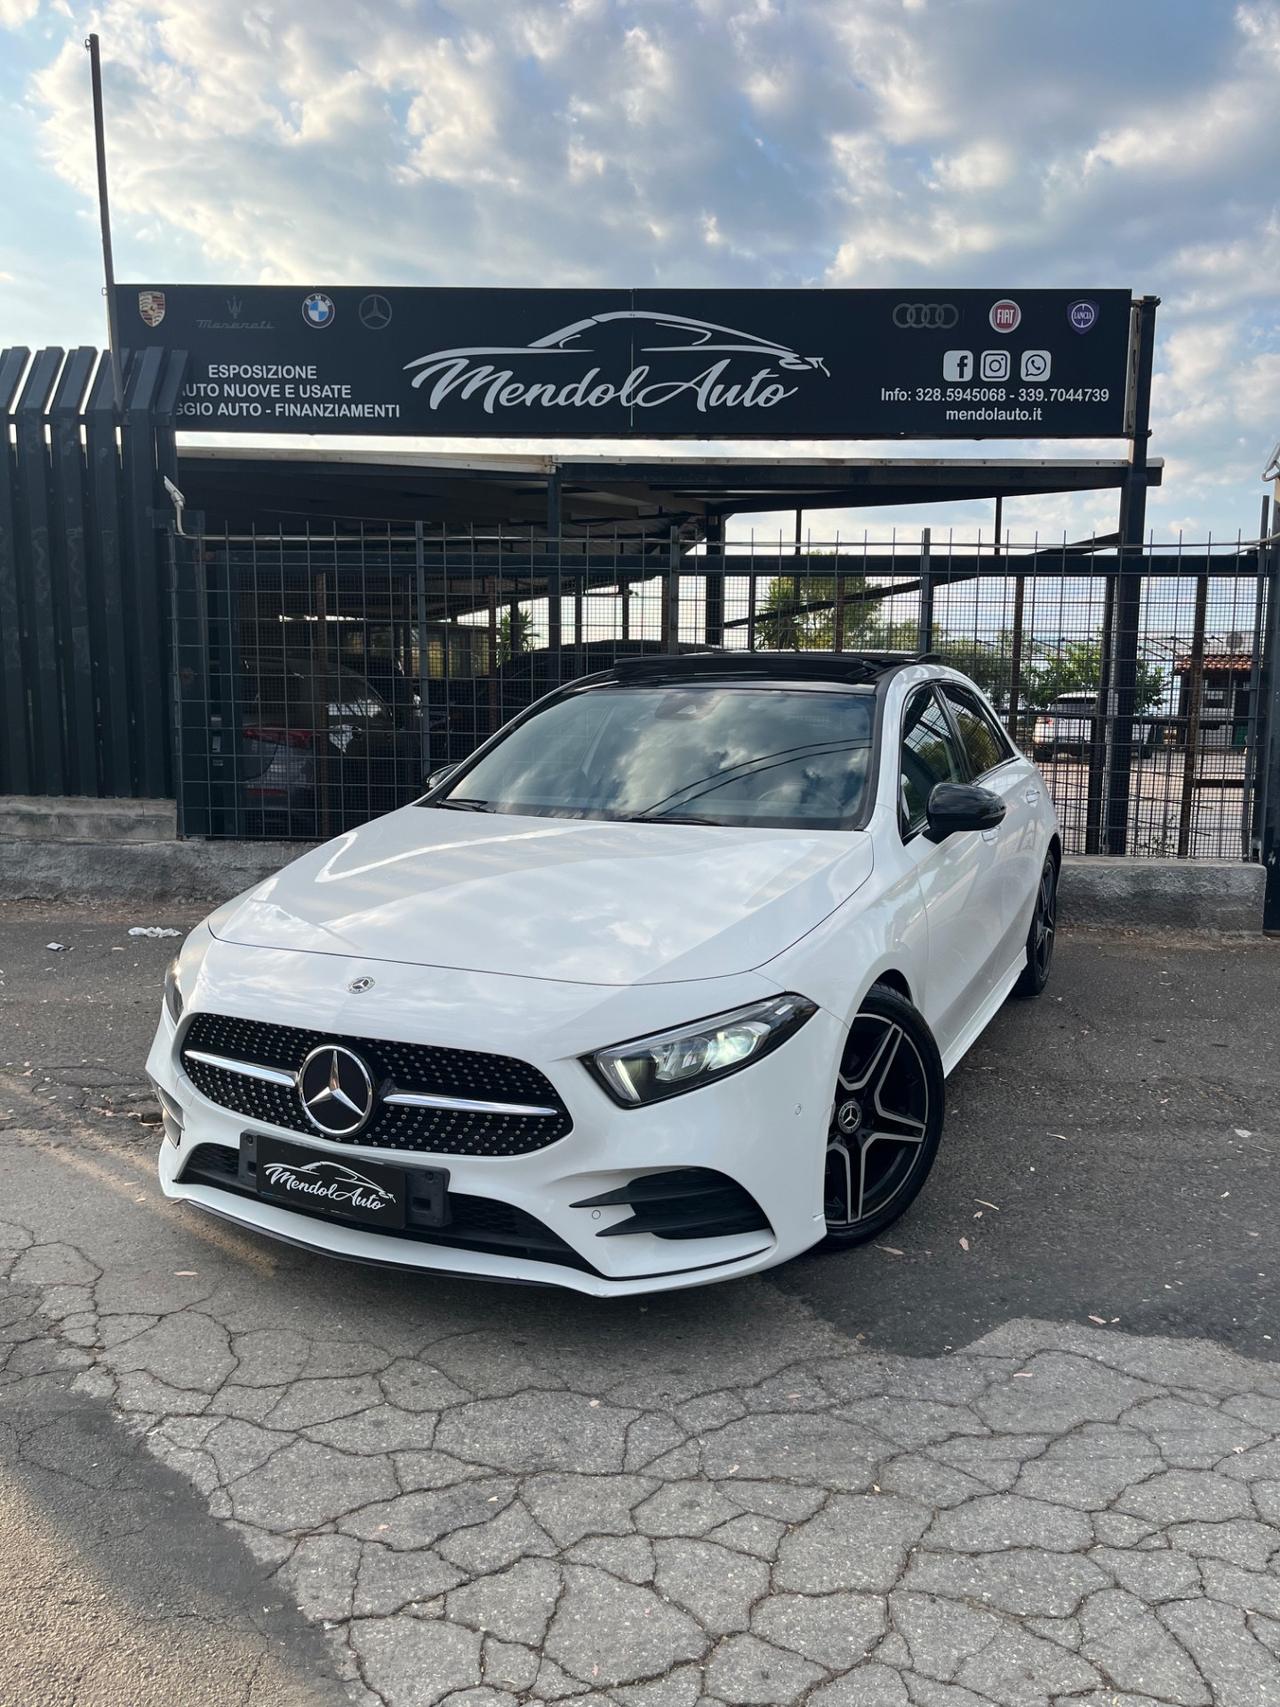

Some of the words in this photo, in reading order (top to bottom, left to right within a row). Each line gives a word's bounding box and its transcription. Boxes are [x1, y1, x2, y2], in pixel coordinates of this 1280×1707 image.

[996, 309, 1015, 324] FIAT
[1073, 311, 1092, 320] LANCIA
[208, 364, 317, 379] ESPOSIZIONE
[182, 383, 220, 398] UTO
[223, 383, 281, 398] NUOVE
[285, 384, 295, 398] E
[299, 384, 352, 399] USATE
[881, 387, 912, 402] Info:
[915, 387, 1006, 402] 328.5945068
[1018, 387, 1110, 402] 339.7044739
[217, 402, 262, 417] AUTO
[275, 402, 400, 418] FINANZIAMENTI
[945, 407, 1043, 421] mendolauto.it
